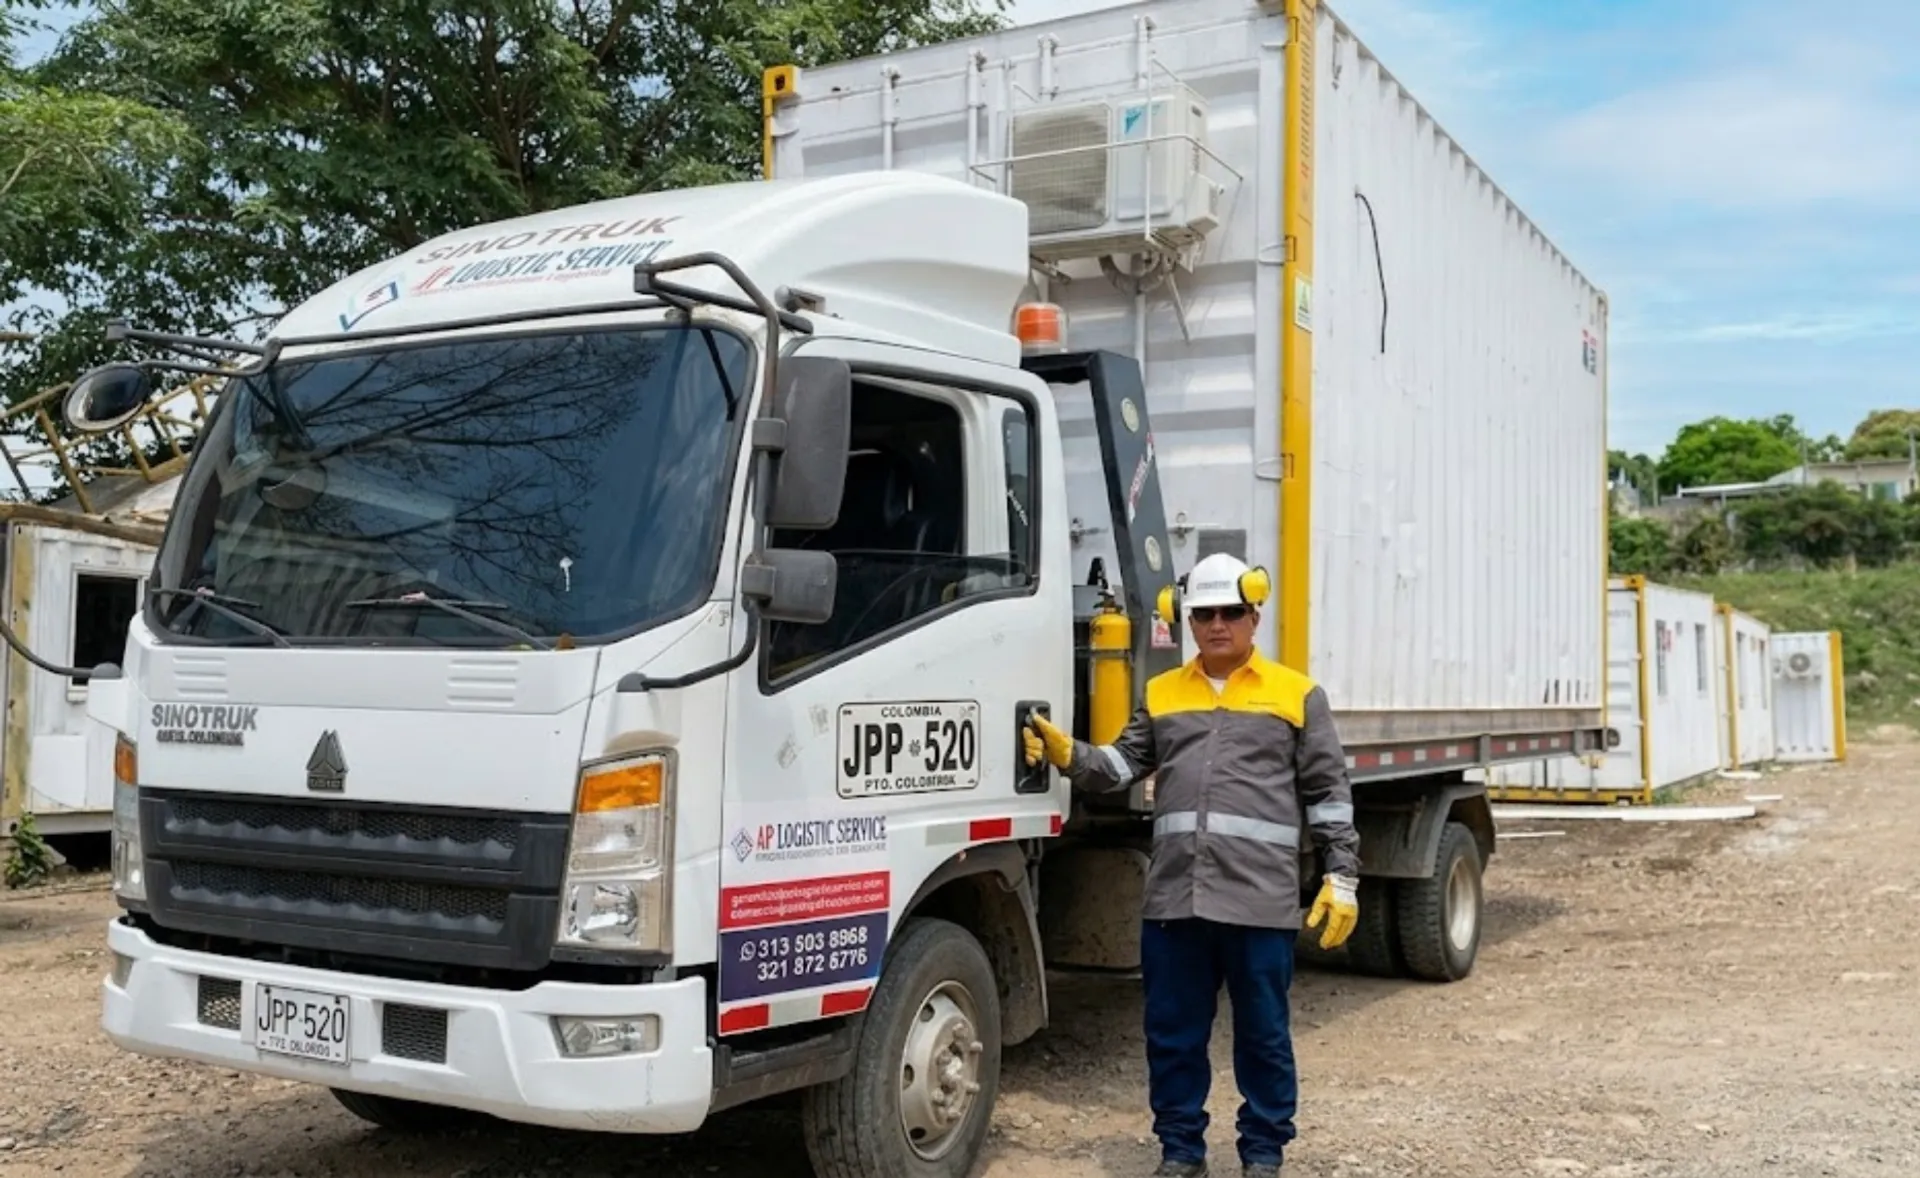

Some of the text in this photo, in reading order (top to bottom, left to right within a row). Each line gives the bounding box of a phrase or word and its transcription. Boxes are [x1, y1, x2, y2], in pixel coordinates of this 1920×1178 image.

[416, 216, 684, 265] SINOTRUK
[151, 704, 258, 730] SINOTRUK
[881, 706, 942, 718] COLOMBIA
[843, 719, 975, 777] JPP 520
[757, 816, 887, 850] AP LOGISTIC SERVICE
[758, 937, 790, 958] 313
[757, 960, 788, 981] 321
[794, 953, 825, 975] 872
